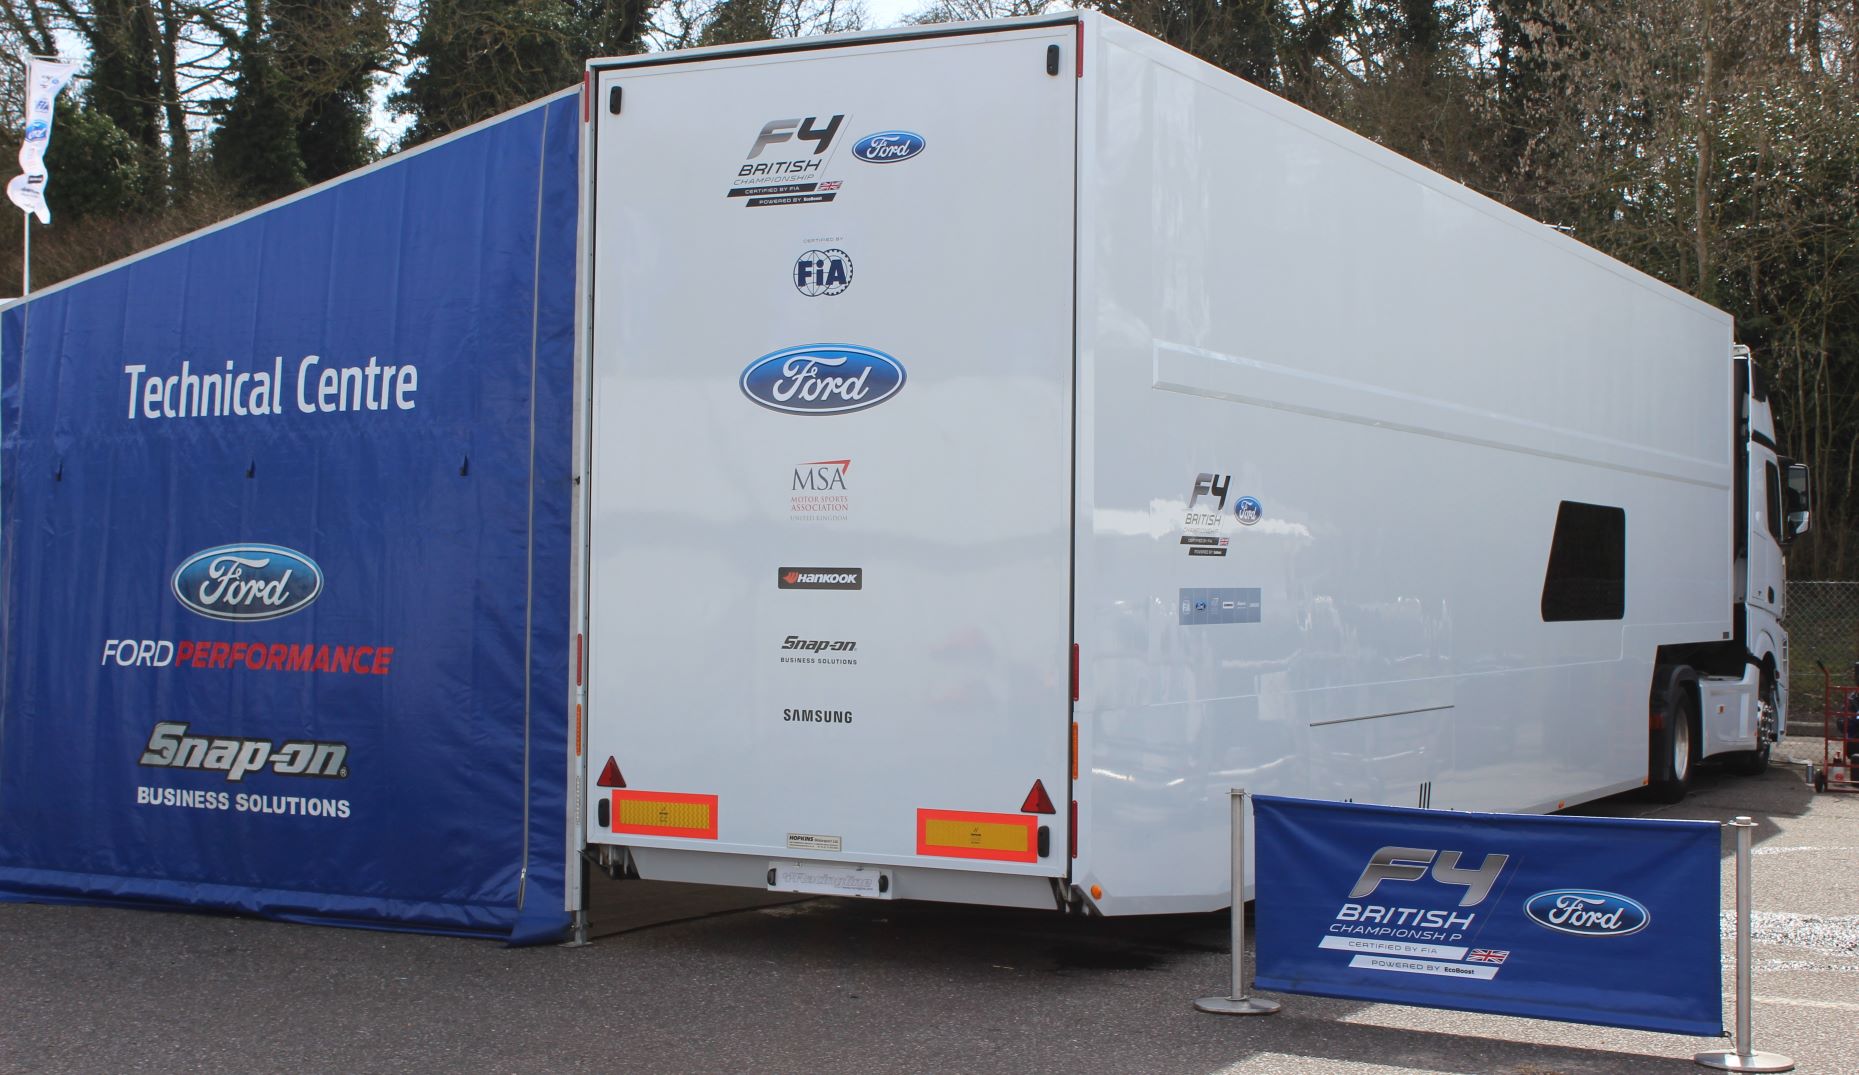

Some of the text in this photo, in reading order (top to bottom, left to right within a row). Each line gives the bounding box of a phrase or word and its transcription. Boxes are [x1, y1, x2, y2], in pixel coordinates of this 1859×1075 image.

[746, 114, 845, 160] F4
[867, 137, 911, 159] Ford
[737, 159, 823, 177] BRITISH
[733, 174, 815, 186] CHAMPIONSHIP
[745, 186, 778, 195] CERTIFIED
[759, 197, 792, 205] POWERED
[124, 355, 418, 419] Technical Centre
[772, 355, 872, 402] Ford
[791, 467, 848, 491] MSA
[790, 495, 848, 503] MOTOR SPORTS
[1188, 472, 1231, 511] F4
[790, 503, 849, 512] ASSOCIATION
[1239, 501, 1257, 521] Ford
[1185, 513, 1222, 526] BRITISH
[199, 555, 294, 606] Ford
[101, 639, 395, 675] FORD PERFORMANCE
[783, 708, 853, 723] SAMSUNG
[137, 786, 351, 818] BUSINESS SOLUTIONS
[1347, 845, 1510, 907] F4
[1335, 903, 1476, 930] BRITISH
[1547, 894, 1623, 931] Ford
[1329, 923, 1463, 942] CHAMPIONSHP
[1348, 940, 1438, 955] CERTIFIED BY FIA
[1371, 959, 1476, 975] POWERED BY EcoBoost
